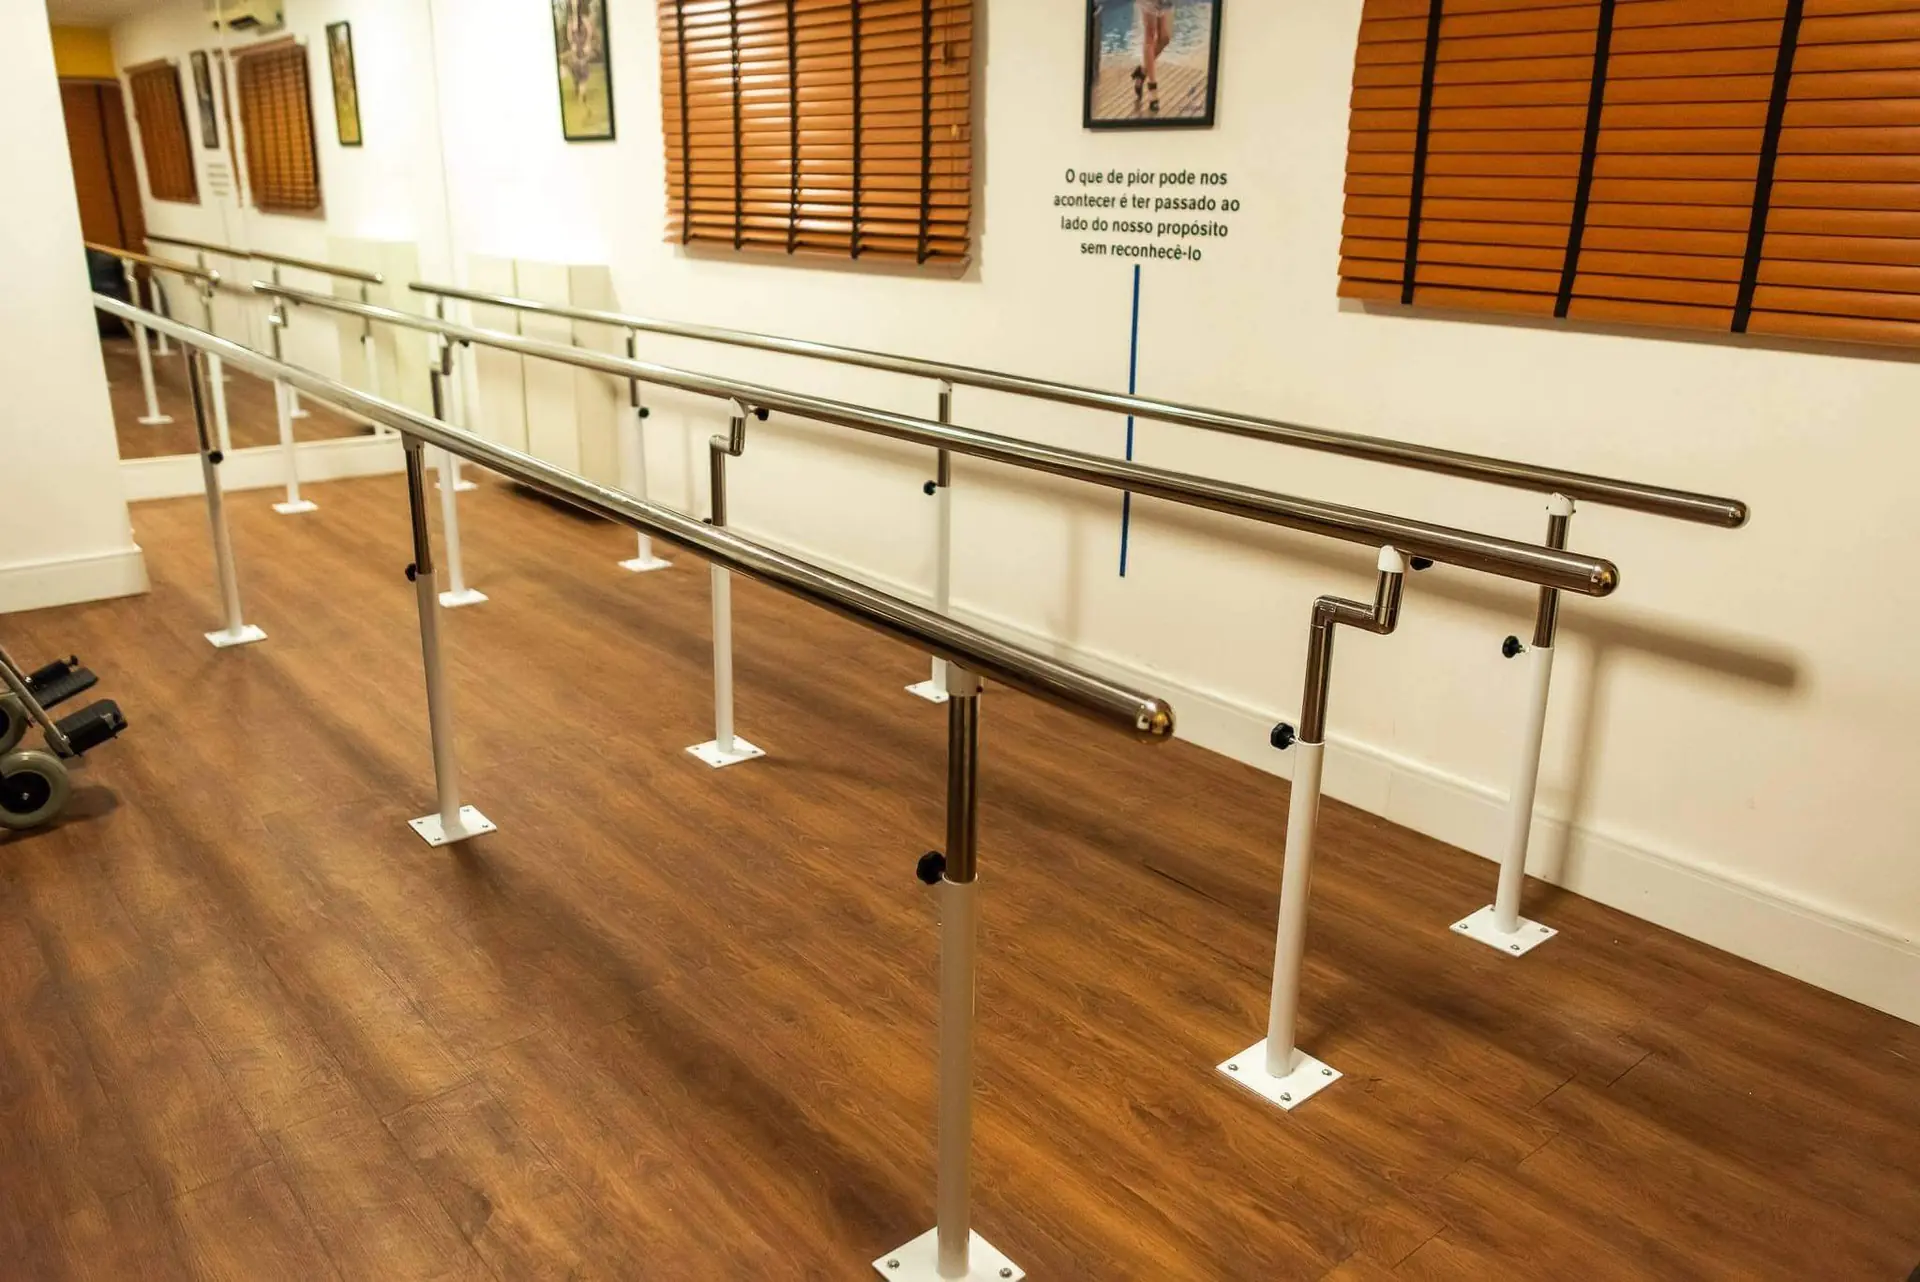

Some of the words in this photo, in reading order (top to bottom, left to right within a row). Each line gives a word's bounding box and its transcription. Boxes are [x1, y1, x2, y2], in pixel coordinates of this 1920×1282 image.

[1065, 168, 1075, 183] O
[1079, 171, 1103, 186] que
[1107, 169, 1123, 184] de
[1128, 169, 1154, 186] pior
[1159, 169, 1195, 187] pode
[1200, 172, 1227, 184] nos
[1054, 193, 1115, 208] acontecer
[1120, 193, 1127, 208] é
[1132, 194, 1150, 208] ter
[1155, 195, 1216, 212] passado
[1221, 199, 1240, 211] ao
[1061, 216, 1087, 230] lado
[1092, 217, 1108, 231] do
[1112, 220, 1153, 233] nosso
[1158, 220, 1228, 238] propósito
[1081, 242, 1106, 255] sem
[1111, 242, 1201, 261] reconhecê-lo
